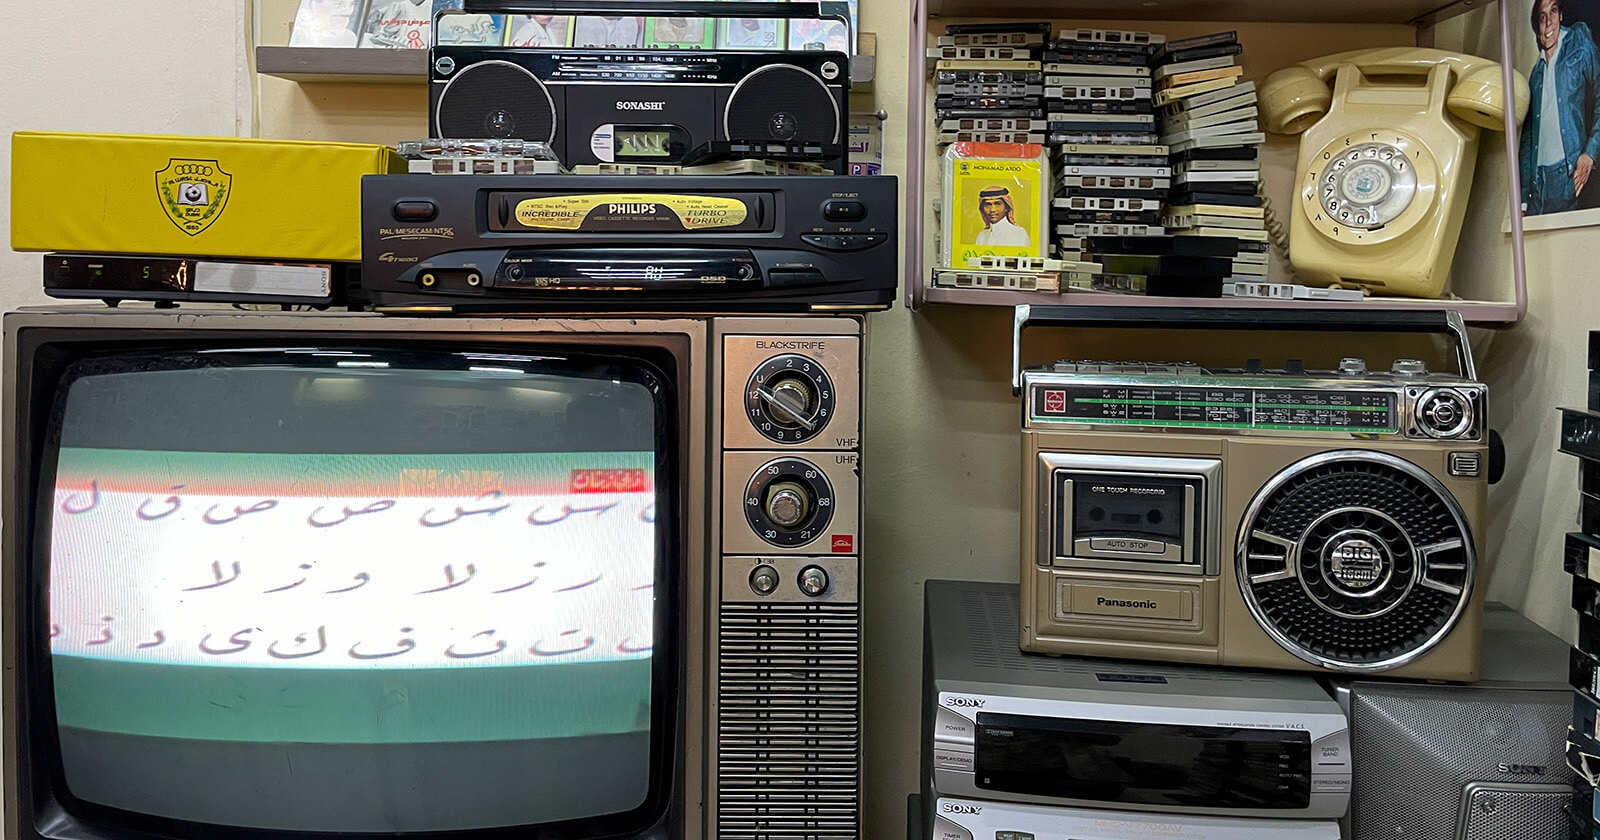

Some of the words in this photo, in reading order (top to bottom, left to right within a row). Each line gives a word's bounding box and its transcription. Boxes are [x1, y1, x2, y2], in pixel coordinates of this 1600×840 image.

[616, 101, 663, 110] SONASHI
[1371, 149, 1377, 157] 3
[1338, 161, 1345, 170] 5
[1328, 174, 1336, 183] 6
[1325, 188, 1333, 198] 7
[608, 203, 656, 214] PHILIPS
[1330, 201, 1337, 211] 8
[1342, 211, 1349, 221] 9
[1357, 215, 1365, 225] 0
[143, 266, 150, 279] 5
[320, 270, 328, 295] SONY
[756, 341, 825, 350] BLACKSTRIFE
[786, 359, 793, 367] 2
[803, 363, 810, 372] 3
[756, 375, 764, 383] U
[816, 375, 822, 383] 4
[748, 391, 759, 399] 12
[822, 391, 829, 399] 5
[751, 409, 760, 417] 11
[820, 409, 827, 417] 6
[761, 422, 771, 431] 10
[777, 431, 784, 440] 9
[795, 431, 802, 439] 8
[836, 438, 856, 447] VHF
[835, 456, 856, 464] UHF
[767, 466, 779, 475] 50
[805, 471, 817, 479] 60
[1130, 487, 1165, 495] RECORDING
[747, 498, 758, 506] 40
[818, 498, 830, 506] 68
[765, 530, 777, 539] 30
[800, 530, 811, 539] 21
[1342, 547, 1372, 559] BIG
[1097, 597, 1157, 609] Panasonic
[946, 696, 985, 708] SONY
[936, 755, 972, 763] DISPLAY/DEMO
[943, 803, 982, 815] SONY
